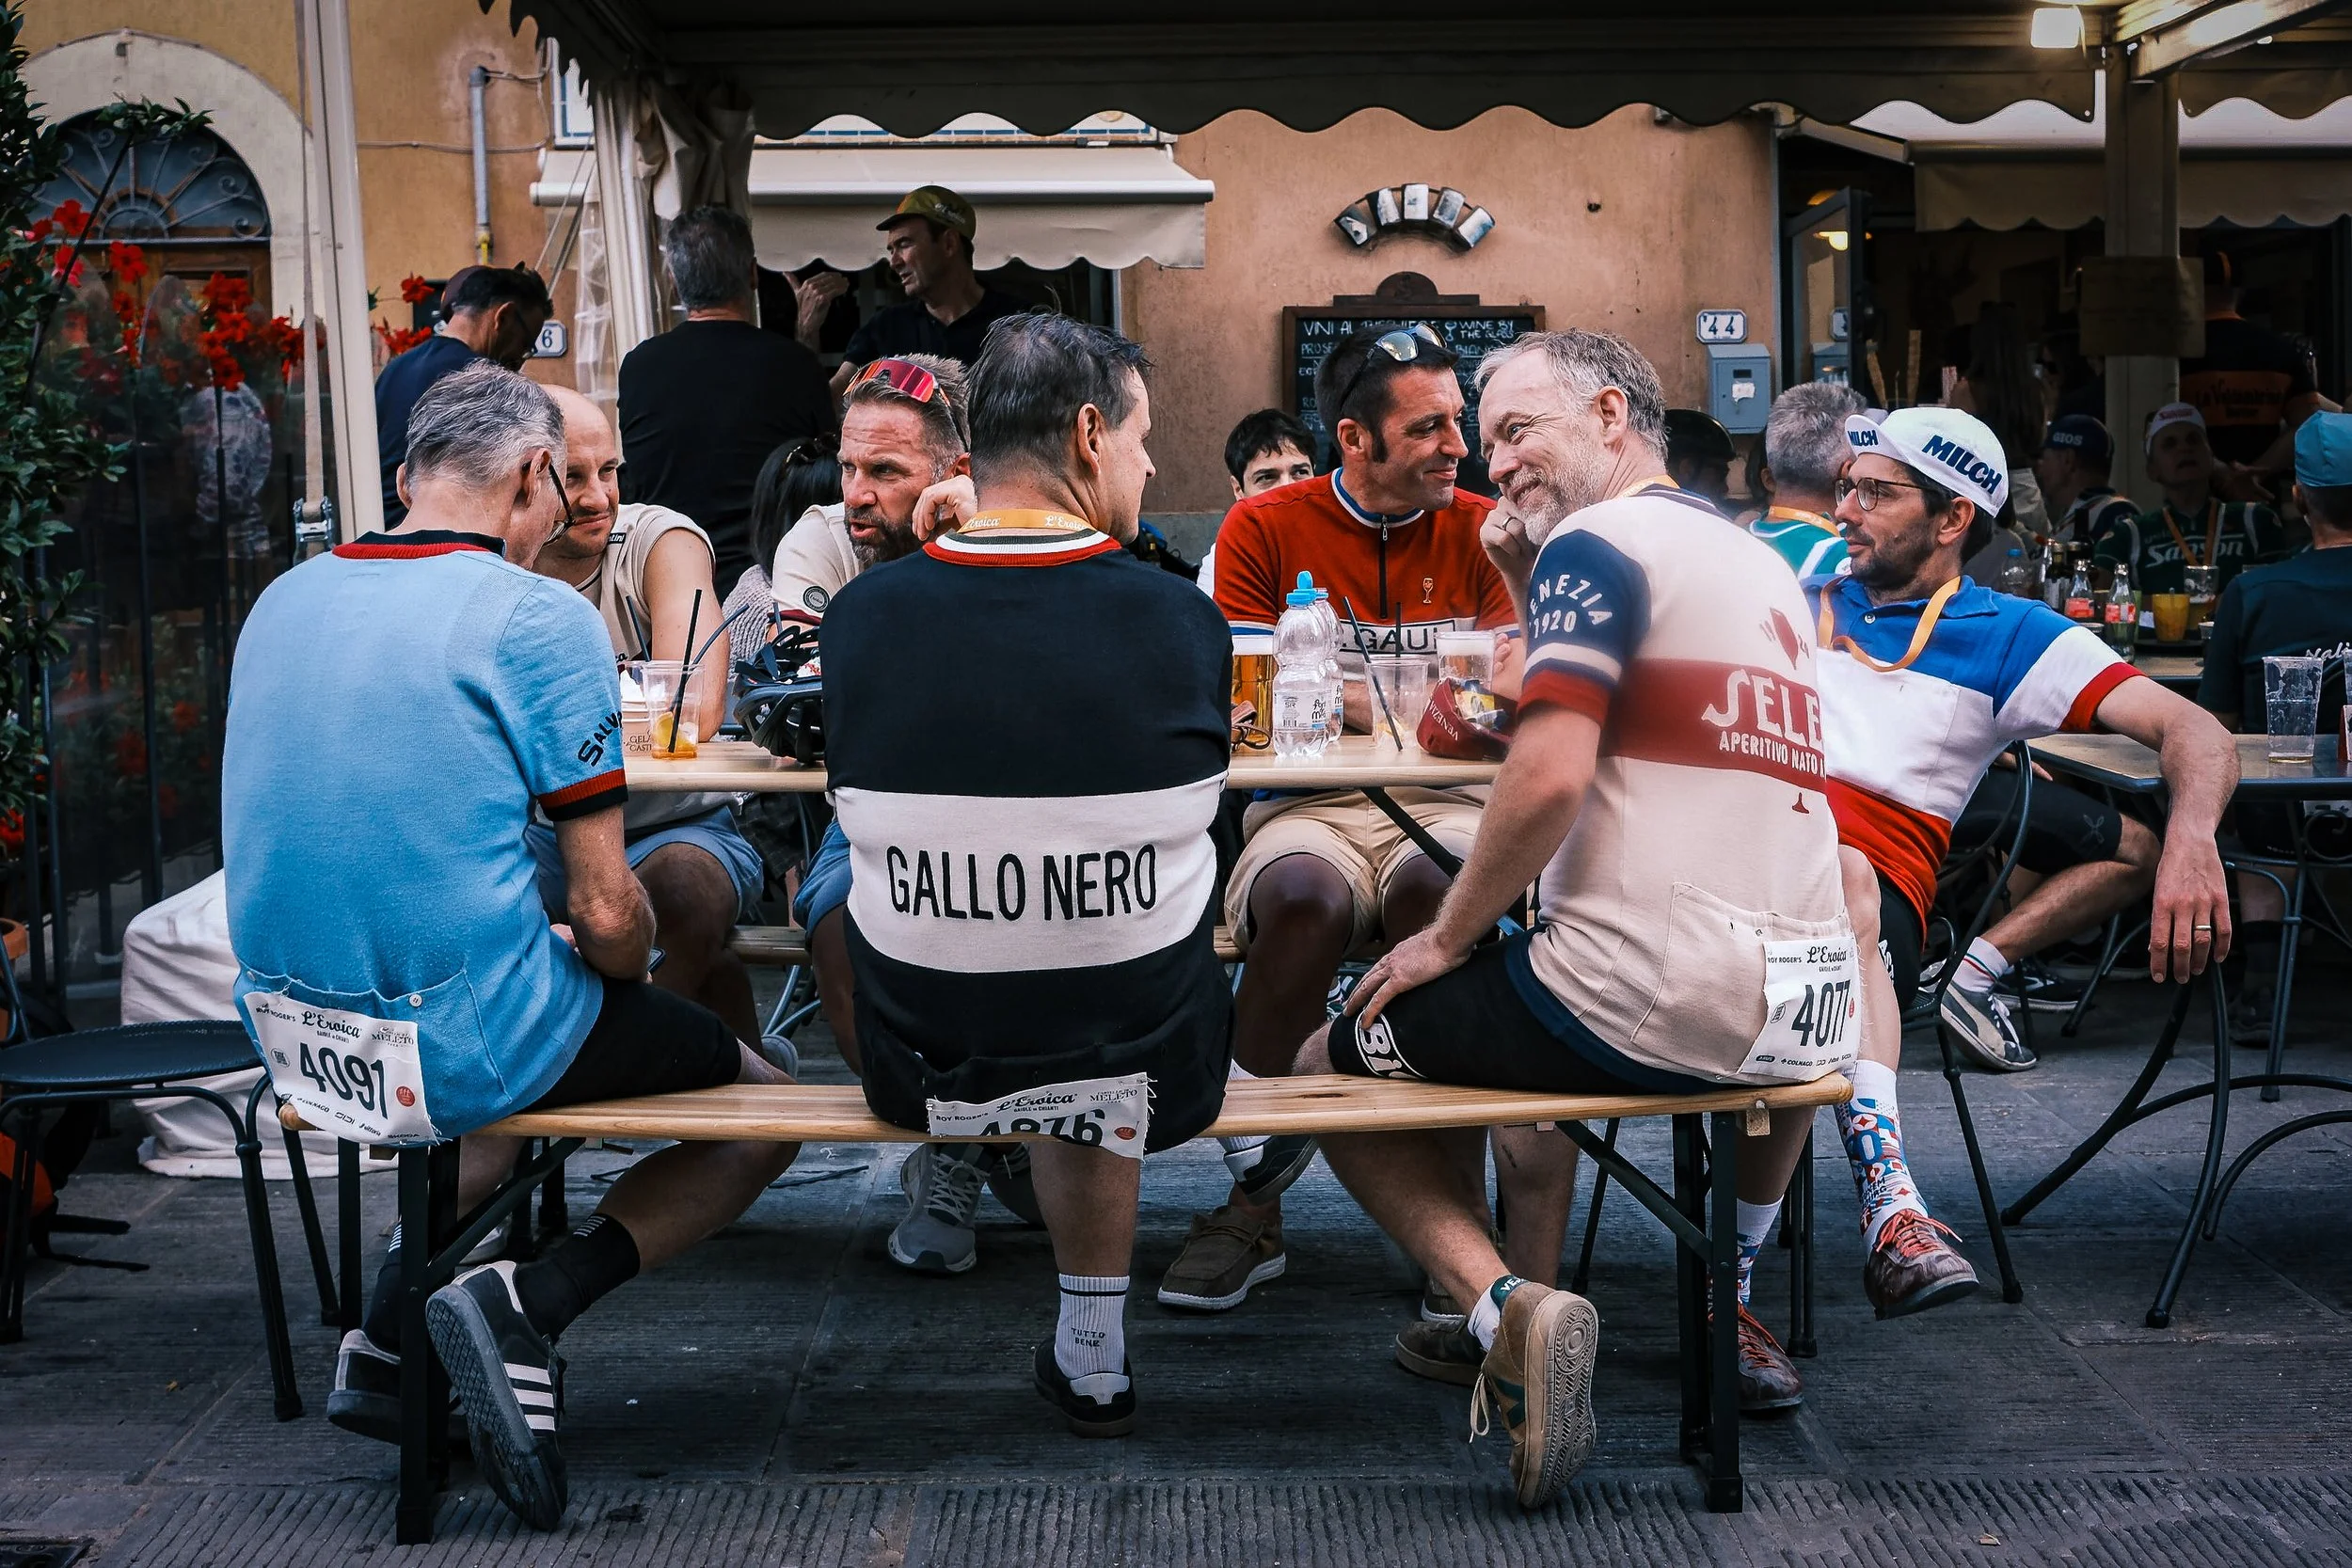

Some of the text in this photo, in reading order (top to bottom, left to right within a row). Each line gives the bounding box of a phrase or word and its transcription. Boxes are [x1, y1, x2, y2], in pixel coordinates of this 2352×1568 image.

[1303, 321, 1334, 336] VINI
[1459, 321, 1514, 330] WINE BY
[1460, 329, 1515, 339] THE GLASS
[1708, 316, 1735, 335] 44
[1301, 342, 1337, 355] PROSE
[1455, 344, 1495, 355] BIAN
[1848, 429, 1879, 447] MILCH
[2052, 432, 2083, 446] GIOS
[1922, 435, 2002, 495] MILCH
[1530, 574, 1613, 626] ENEZIA
[1534, 610, 1577, 639] 1920
[1429, 700, 1459, 741] VENEZIA
[1719, 730, 1788, 766] APERITIVO
[1791, 748, 1818, 774] NATO
[886, 844, 1157, 921] GALLO NERO
[1806, 945, 1847, 964] L'Eroica
[1791, 979, 1851, 1047] 4077
[301, 1010, 361, 1038] L'Eroica
[300, 1041, 389, 1119] 4091
[996, 1091, 1078, 1114] L'Eroica
[1071, 1327, 1106, 1338] TUTTO
